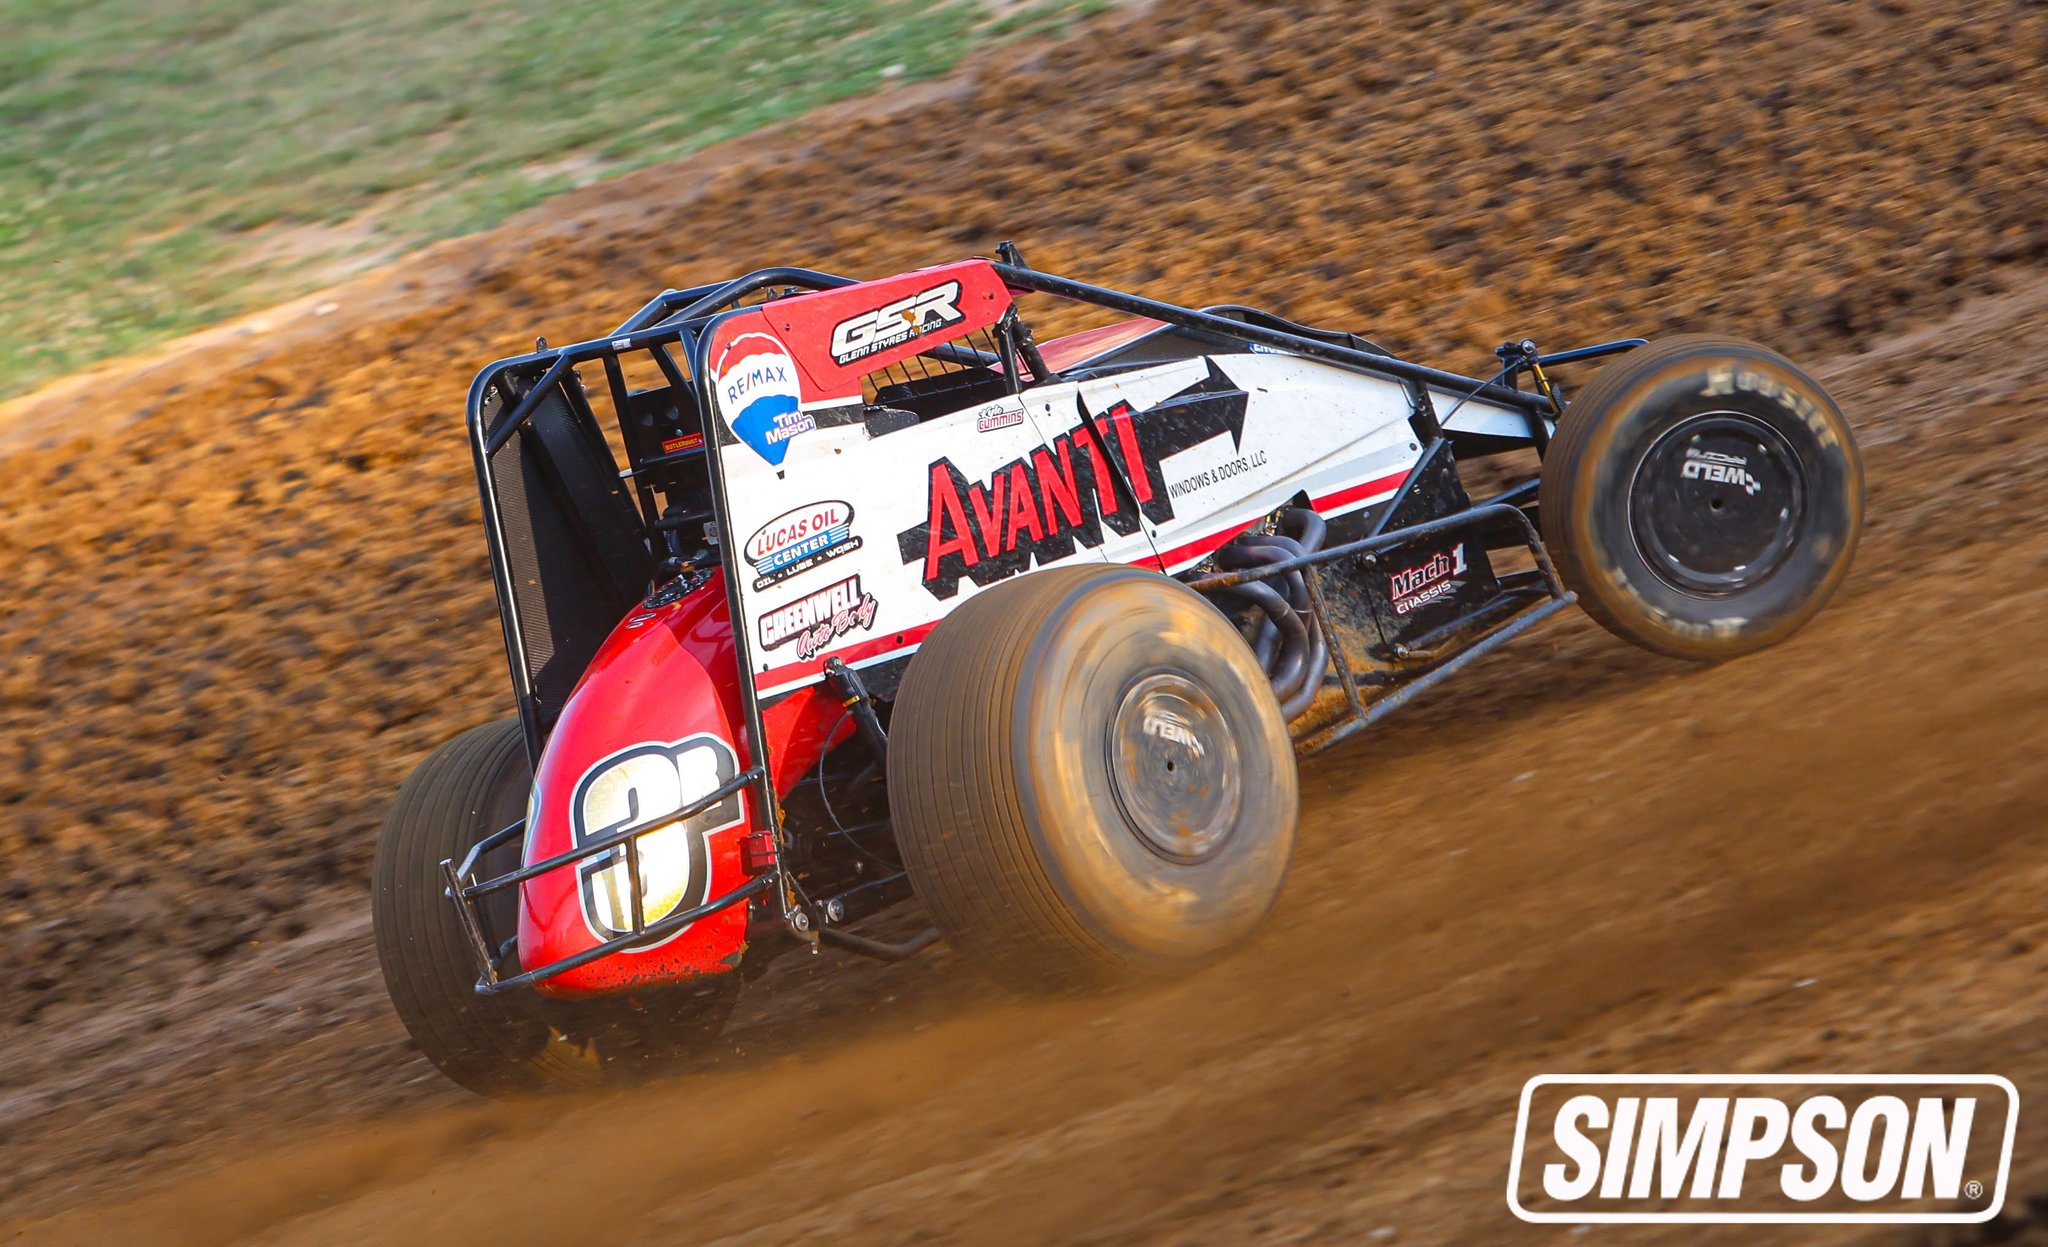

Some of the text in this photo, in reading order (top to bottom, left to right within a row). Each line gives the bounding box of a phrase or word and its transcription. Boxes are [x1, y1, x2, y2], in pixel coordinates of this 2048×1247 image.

[832, 281, 961, 357] GSR
[839, 348, 869, 364] GLENN
[871, 332, 908, 352] STYRES
[728, 366, 787, 404] RE/MAX
[765, 416, 815, 445] Mason
[773, 410, 801, 428] Tim
[1169, 450, 1267, 499] WINDOWS & DOORS, LLC
[1681, 460, 1746, 486] WELD
[925, 404, 1154, 581] AVANTI
[757, 508, 839, 556] LUCAS OIL
[773, 534, 829, 566] CENTER
[756, 577, 775, 589] OIL
[1391, 543, 1467, 600] Mach 1
[760, 577, 860, 647] GREENWELL
[1396, 580, 1452, 614] CHASSIS
[798, 623, 834, 657] Auto
